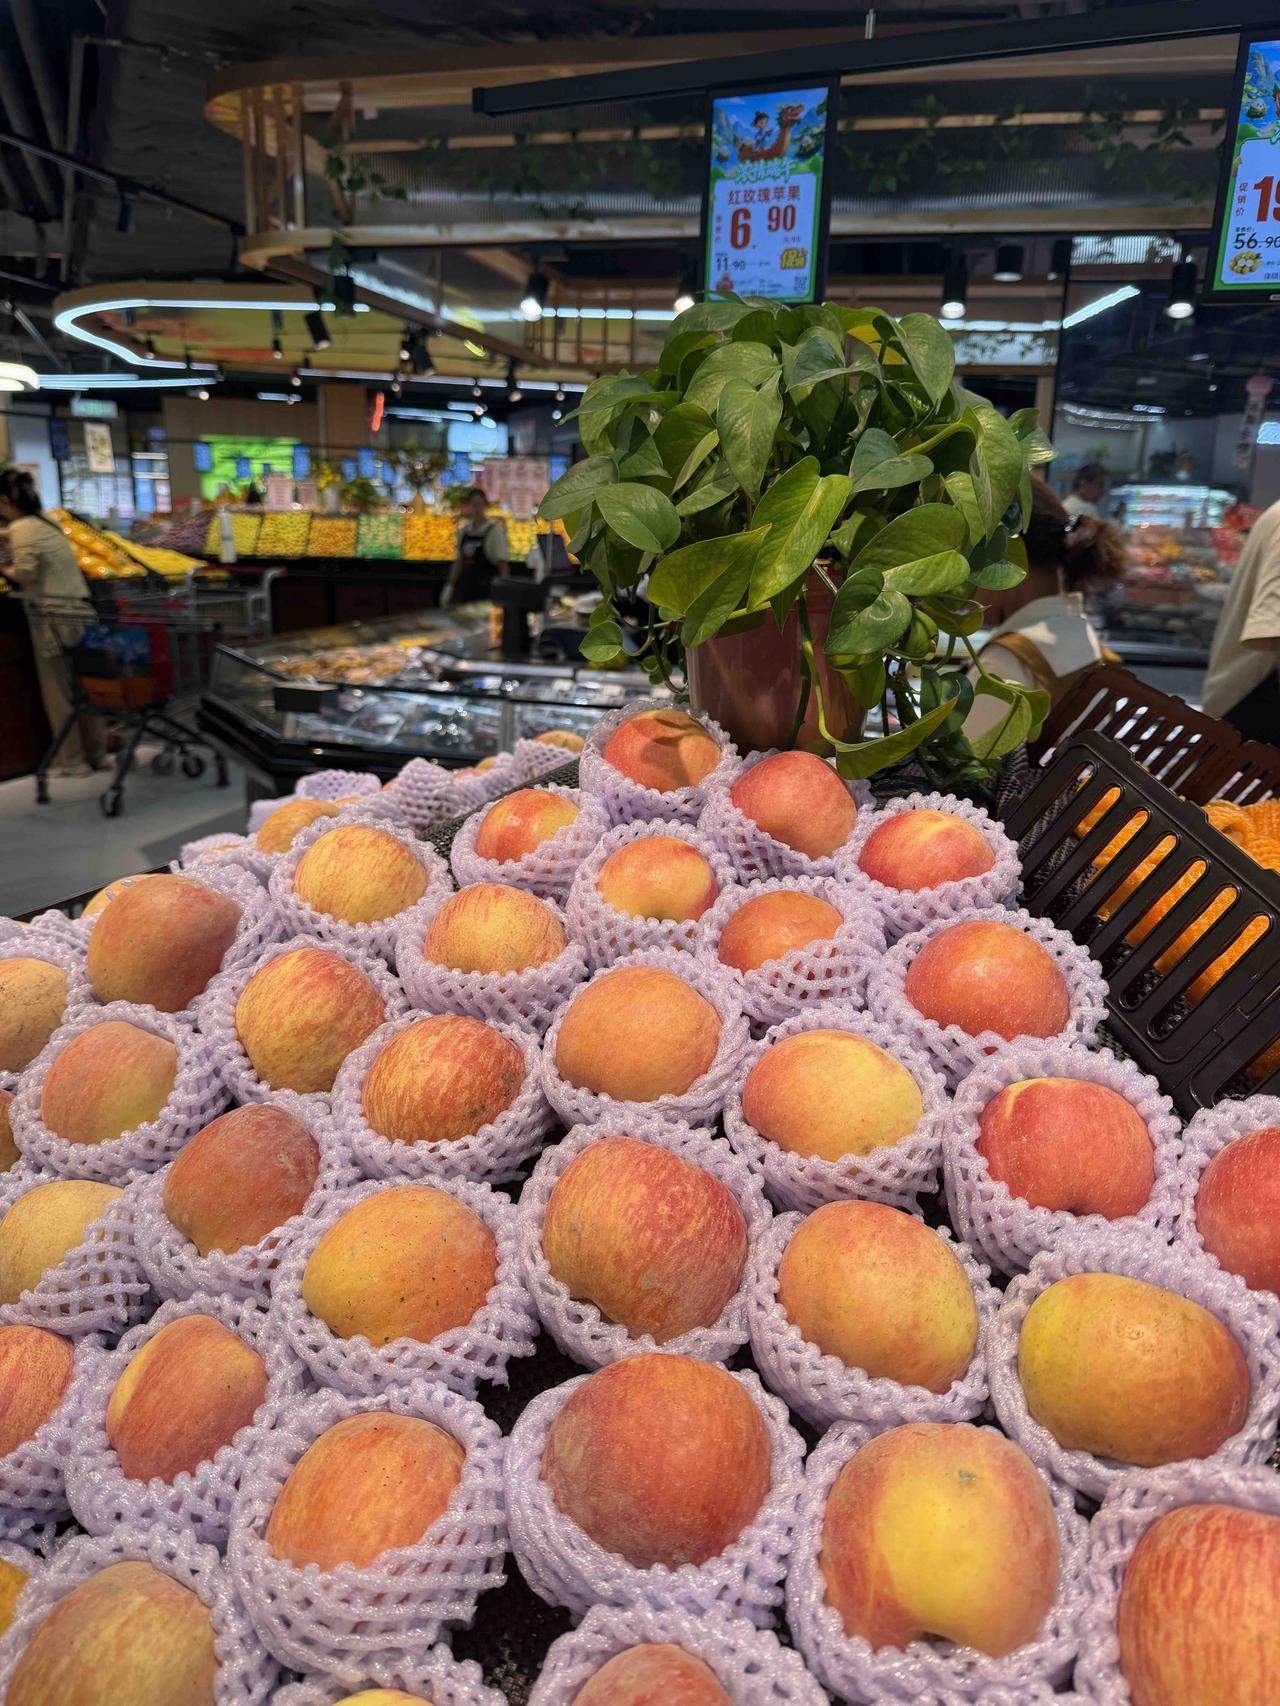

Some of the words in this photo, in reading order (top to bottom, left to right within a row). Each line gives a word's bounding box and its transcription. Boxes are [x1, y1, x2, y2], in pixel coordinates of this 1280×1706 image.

[728, 185, 800, 205] 红玫瑰苹果
[1233, 232, 1280, 249] 56.90
